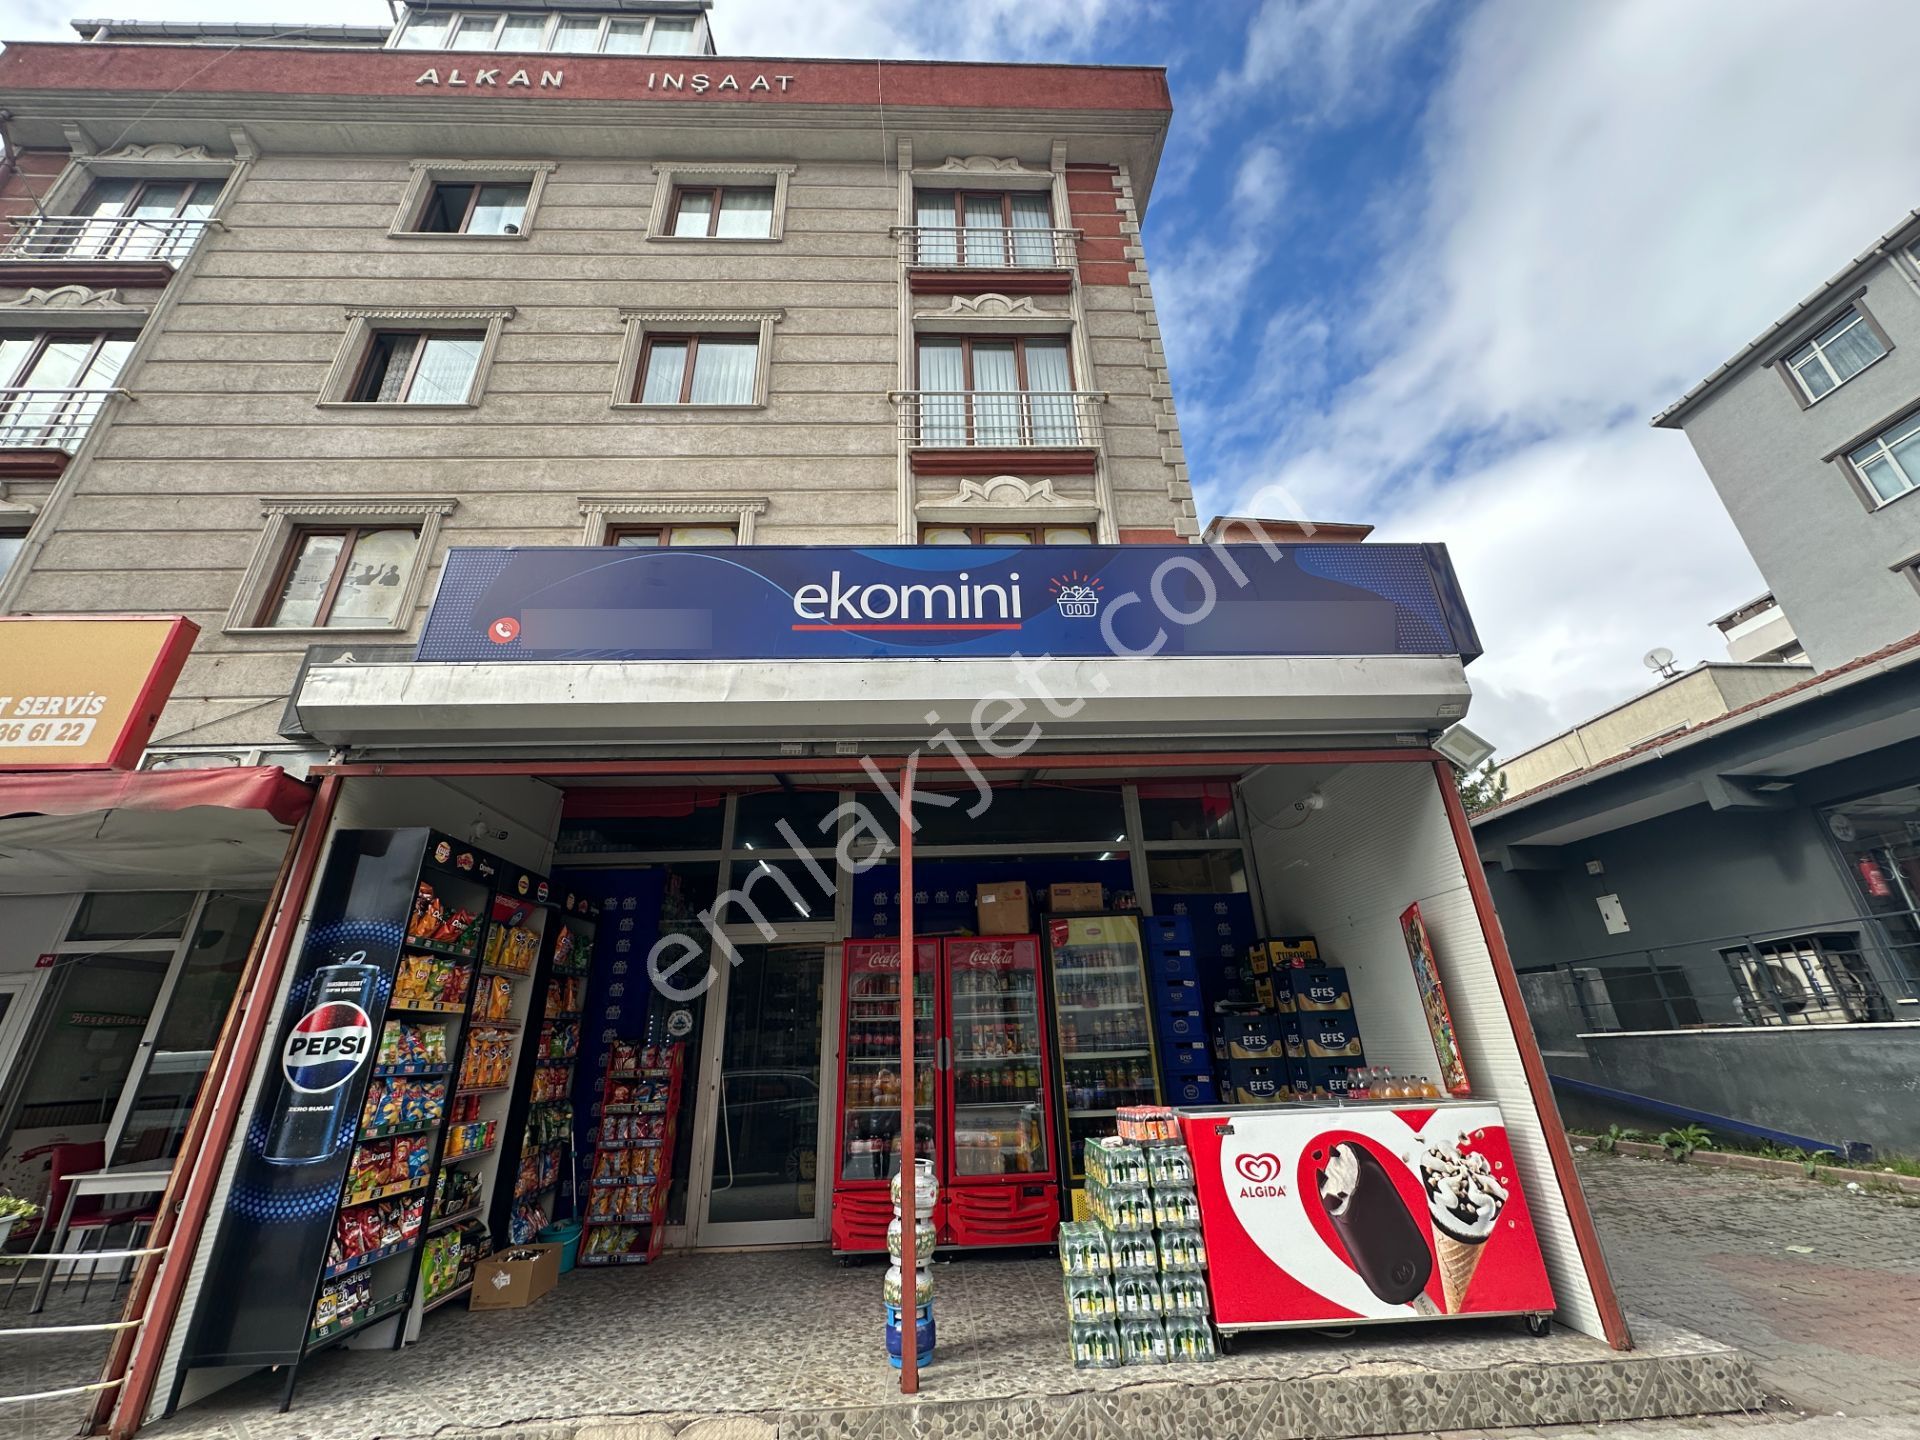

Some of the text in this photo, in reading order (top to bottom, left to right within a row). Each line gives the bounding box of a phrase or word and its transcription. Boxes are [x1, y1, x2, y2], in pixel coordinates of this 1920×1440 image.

[415, 68, 564, 89] ALKAN
[792, 570, 1022, 620] ekomini
[54, 722, 86, 741] 22
[1310, 987, 1335, 998] EFES
[1242, 1034, 1268, 1046] EFES
[1320, 1032, 1346, 1044] EFES
[288, 1035, 367, 1056] PEPSI
[1250, 1079, 1275, 1091] EFES
[1328, 1079, 1347, 1091] EFE
